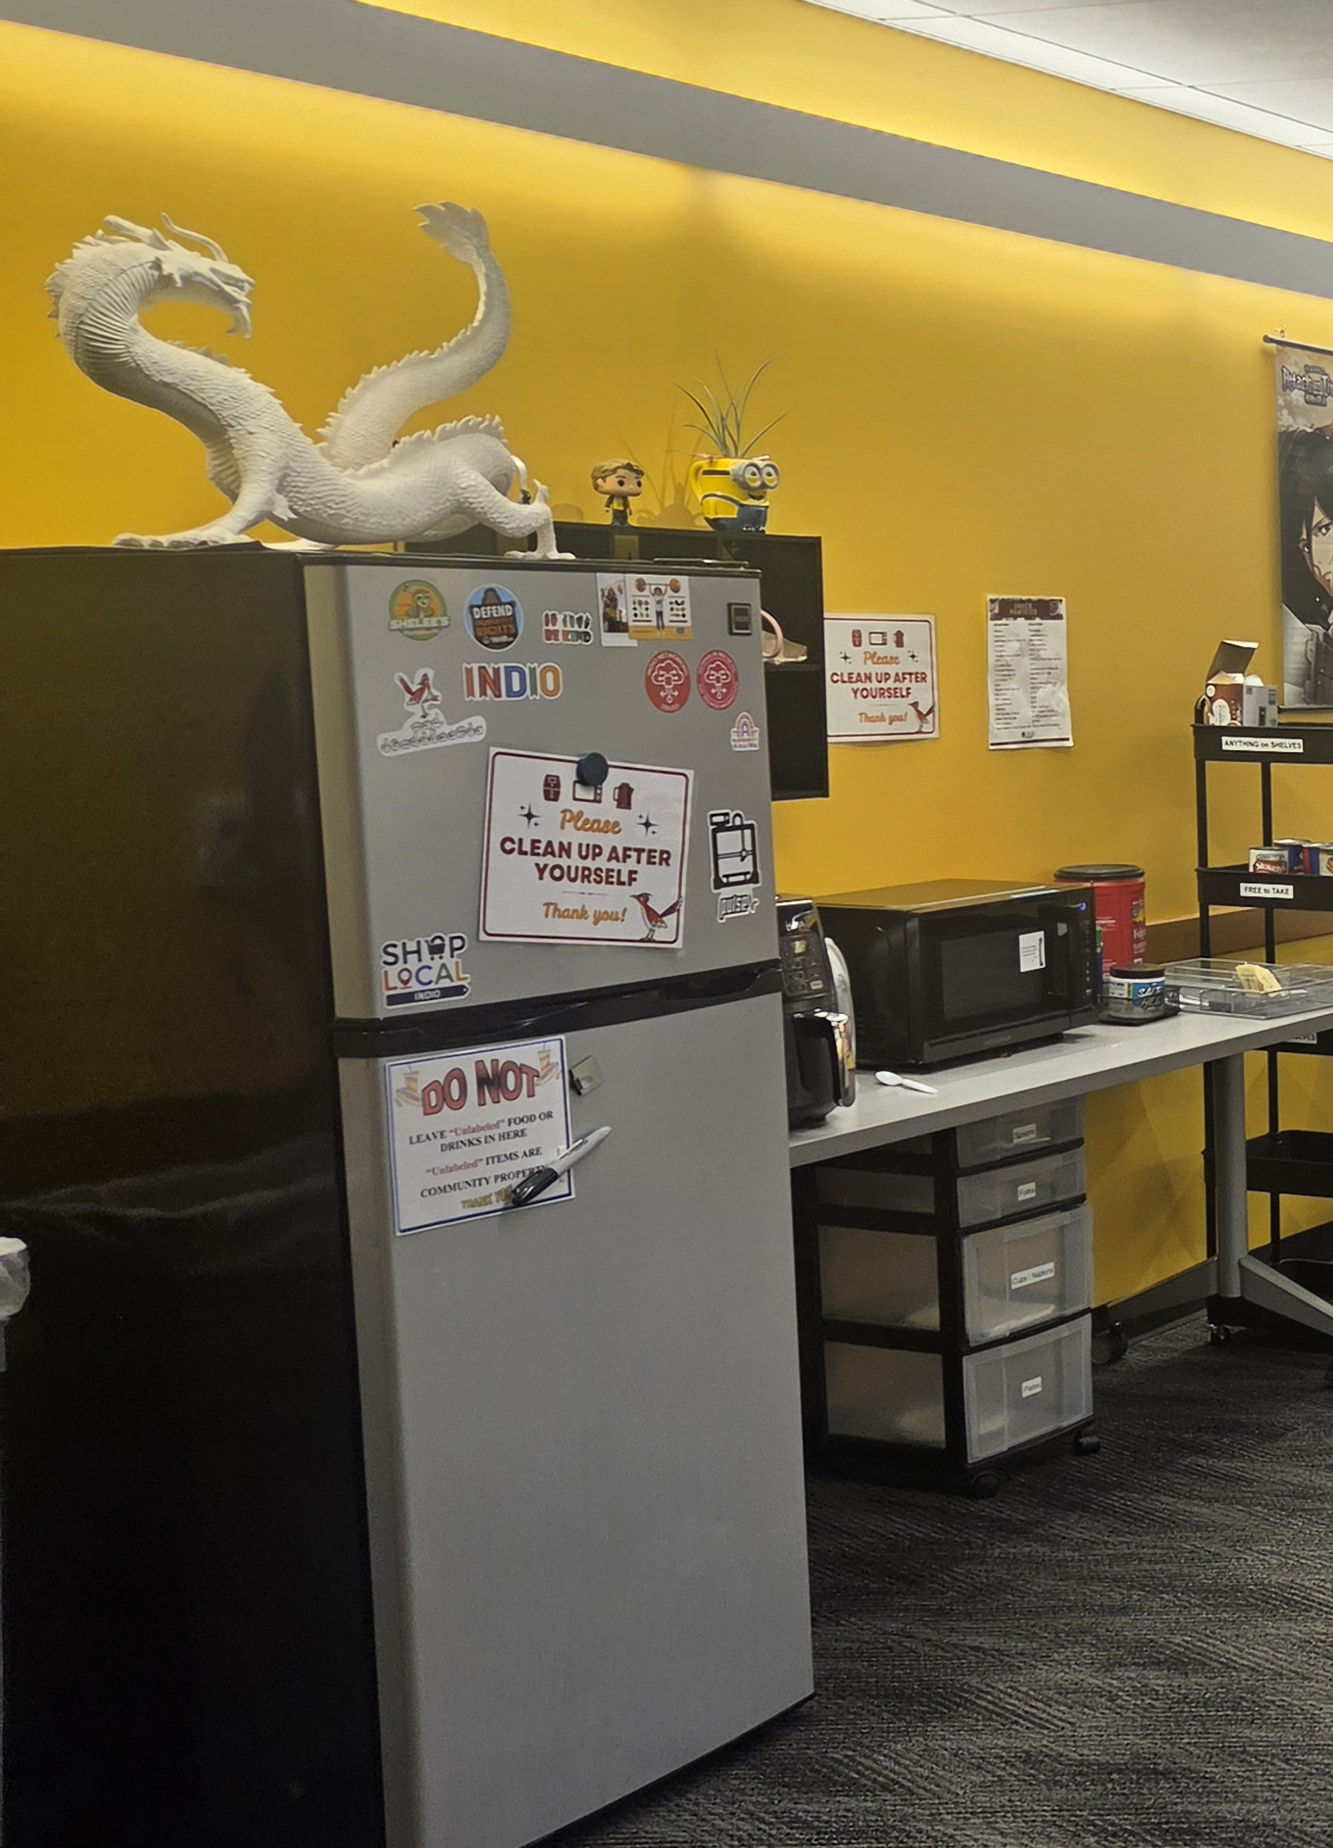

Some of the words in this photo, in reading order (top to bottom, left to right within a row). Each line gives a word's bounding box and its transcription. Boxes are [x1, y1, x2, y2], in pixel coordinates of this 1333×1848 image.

[472, 604, 513, 619] DEFEND
[863, 650, 901, 666] Please
[464, 664, 562, 699] INDIO
[830, 672, 872, 684] CLEAN
[875, 672, 892, 684] UP
[893, 672, 928, 684] AFTER
[851, 686, 912, 700] YOURSELF
[858, 712, 886, 724] Thank
[888, 711, 908, 726] you!
[1224, 740, 1260, 748] ANYTHING
[1270, 742, 1302, 750] SHELVES
[559, 808, 623, 835] Please
[500, 836, 573, 860] CLEAN
[578, 842, 604, 862] UP
[606, 845, 672, 867] AFTER
[534, 862, 638, 887] YOURSELF
[1244, 886, 1262, 894] FREE
[1272, 887, 1290, 895] TAKE
[542, 901, 590, 920] Thank
[592, 907, 628, 926] you!
[382, 935, 466, 966] SHOP
[384, 960, 469, 992] LOCAL
[421, 1067, 468, 1116] DO
[474, 1058, 540, 1107] NOT
[408, 1130, 448, 1146] LEAVE
[507, 1114, 537, 1127] FOOD
[538, 1110, 554, 1121] OR
[440, 1136, 482, 1154] DRINKS
[484, 1133, 496, 1144] IN
[498, 1128, 528, 1142] HERE
[485, 1152, 520, 1166] ITEMS
[520, 1146, 542, 1159] ARE
[420, 1176, 492, 1198] COMMUNITY
